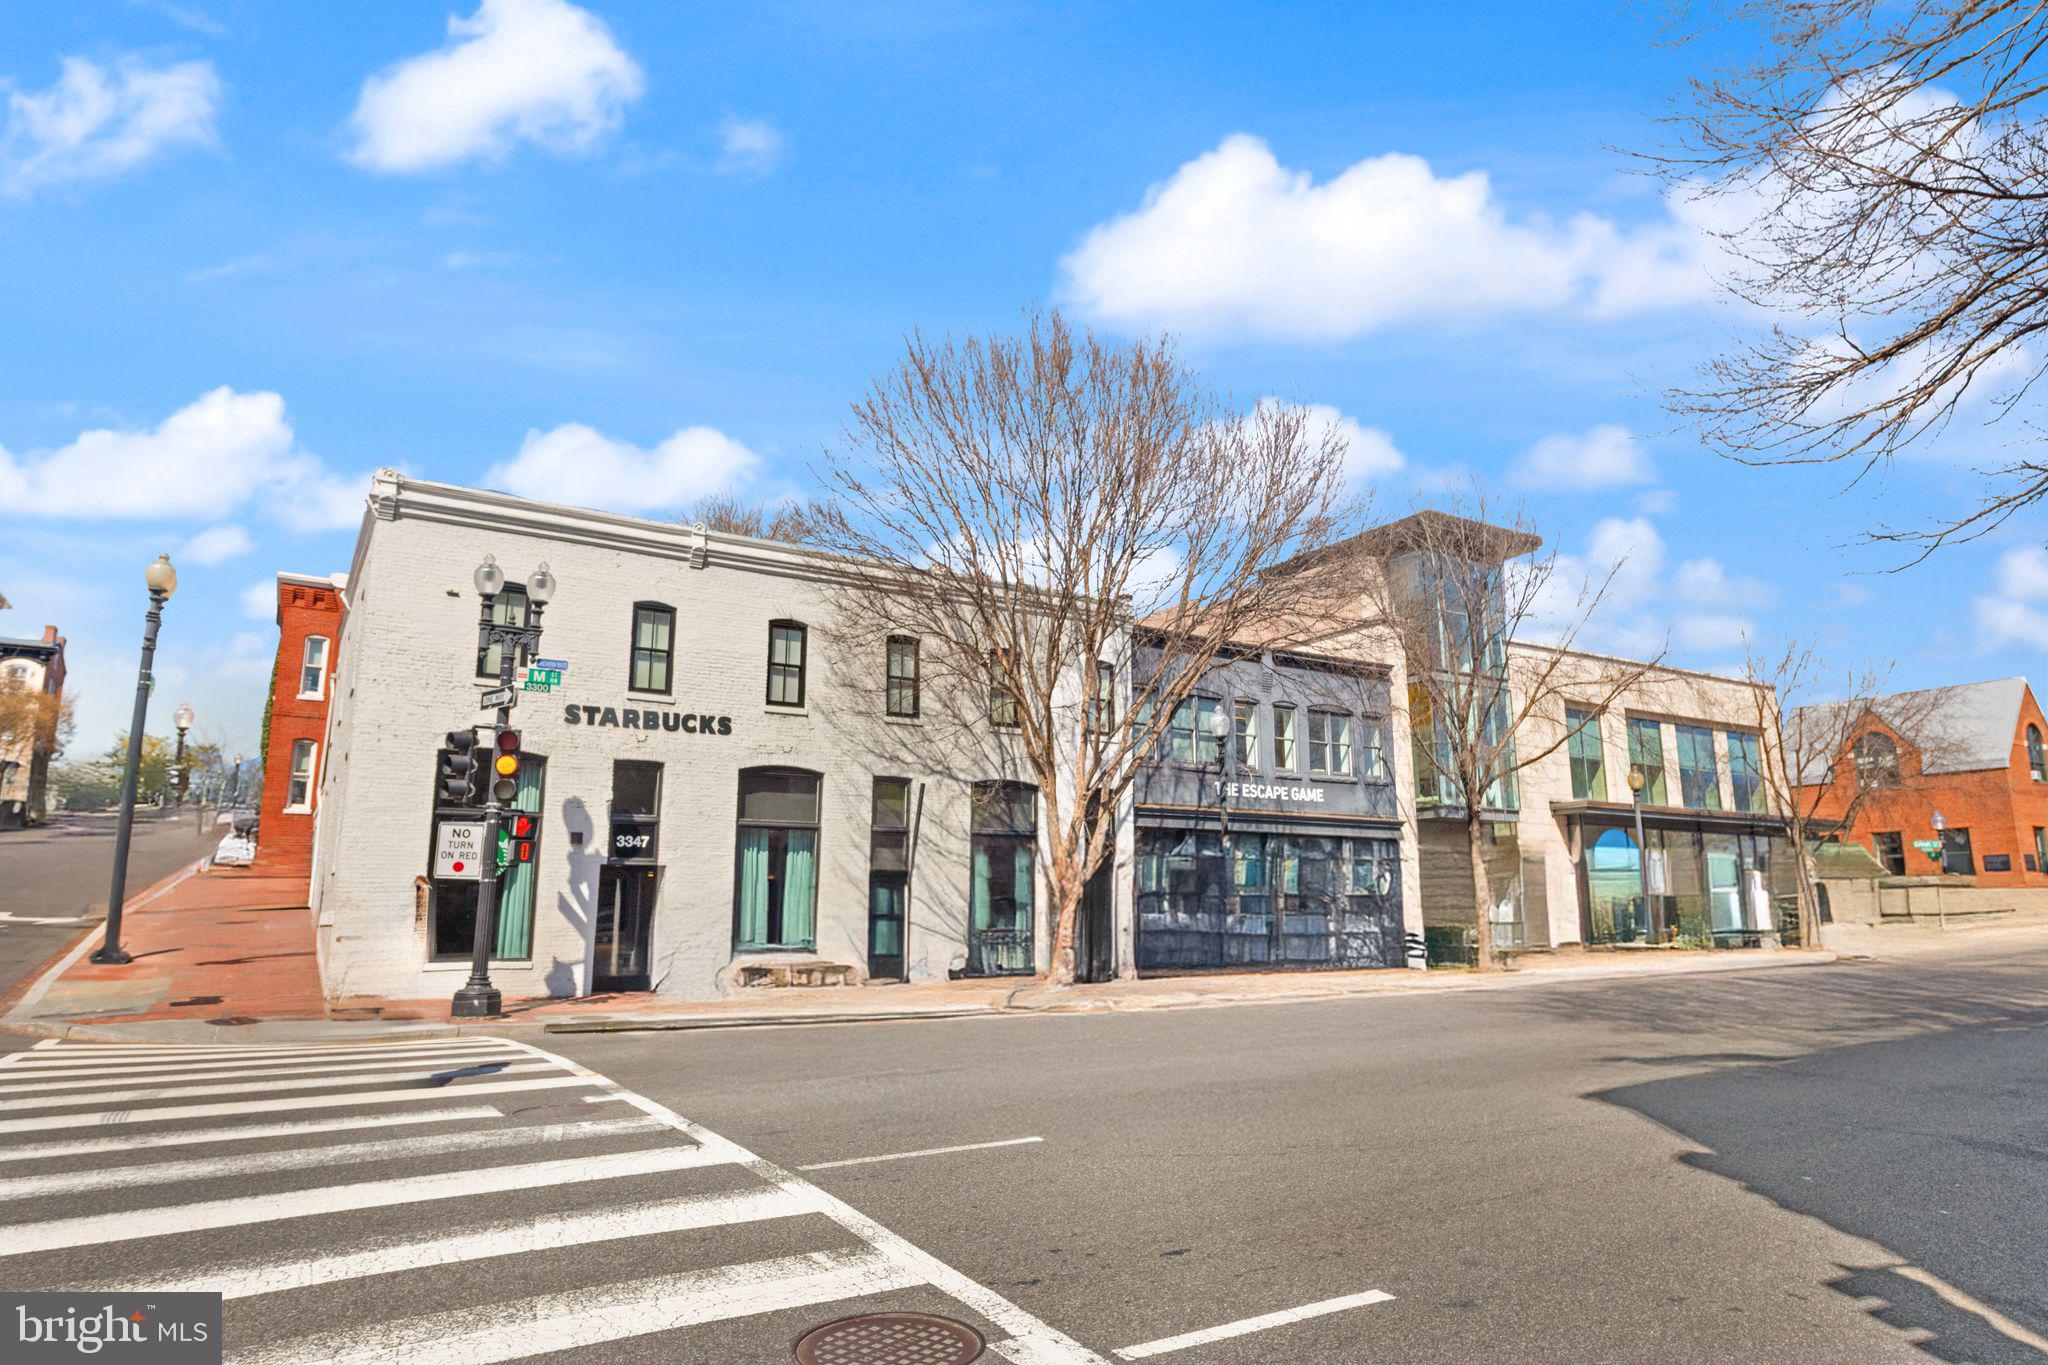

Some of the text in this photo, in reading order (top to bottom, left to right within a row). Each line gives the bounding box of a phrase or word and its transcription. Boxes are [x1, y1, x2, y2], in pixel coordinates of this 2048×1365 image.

[533, 671, 546, 682] M
[526, 682, 549, 692] 3300
[564, 704, 732, 736] STARBUCKS
[1242, 783, 1289, 801] ESCAPE
[1291, 787, 1325, 803] GAME
[452, 828, 471, 839] NO
[448, 840, 474, 849] TURN
[616, 835, 650, 848] 3347
[440, 851, 478, 861] ON RED
